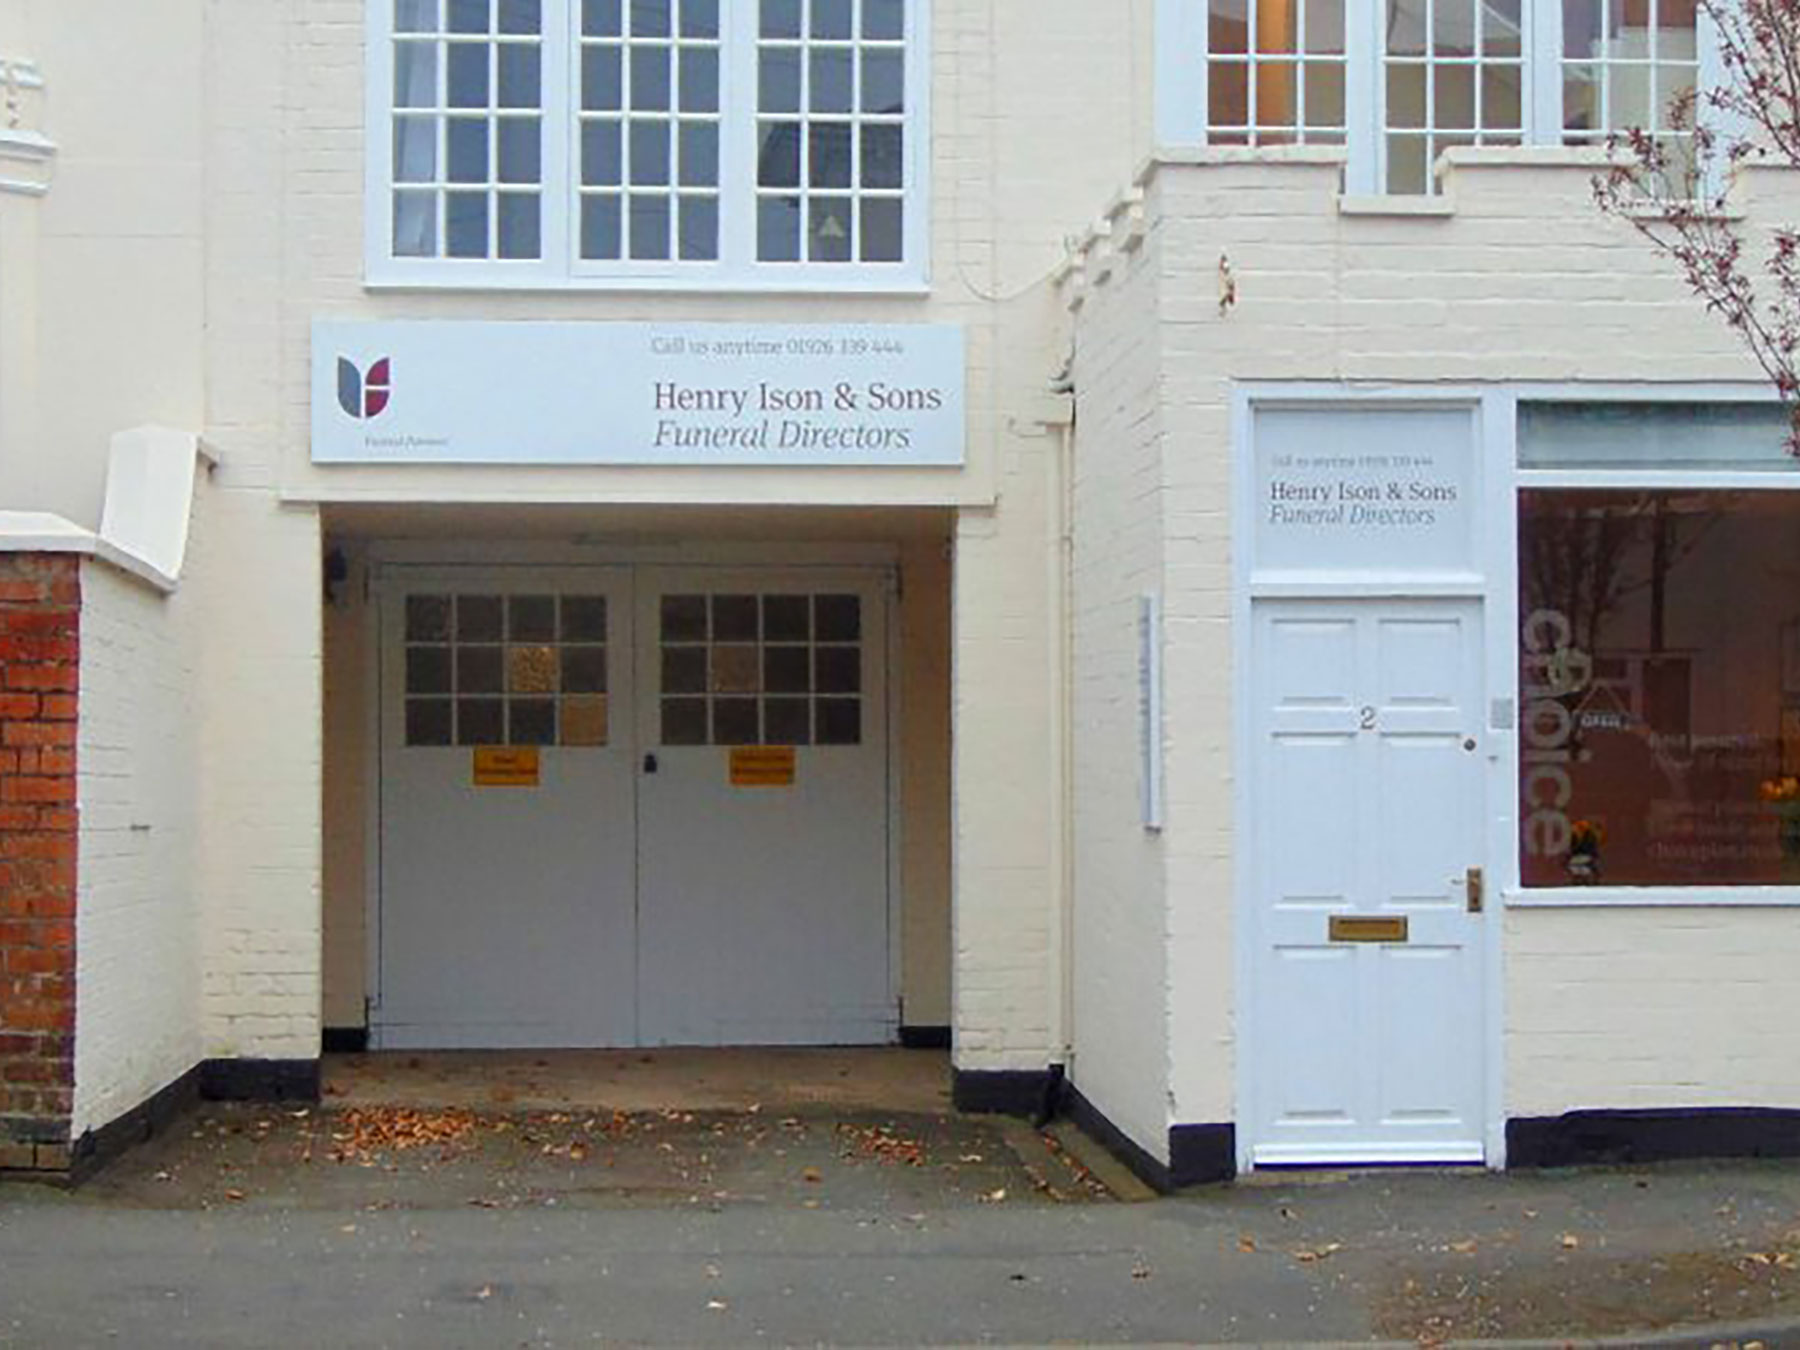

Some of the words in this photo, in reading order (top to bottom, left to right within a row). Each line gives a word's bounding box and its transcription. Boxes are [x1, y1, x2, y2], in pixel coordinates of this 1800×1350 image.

[712, 337, 782, 356] anytime
[654, 381, 748, 417] Henry
[758, 381, 824, 411] Ison
[834, 382, 857, 411] &
[867, 381, 943, 411] Sons
[654, 419, 769, 448] Funeral
[778, 419, 913, 448] Directors
[1270, 481, 1332, 502] Henry
[1338, 481, 1381, 501] Ison
[1386, 481, 1403, 501] &
[1408, 480, 1457, 501] Sons
[1269, 504, 1345, 525] Funeral
[1349, 504, 1436, 525] Directors
[1360, 705, 1376, 730] 2
